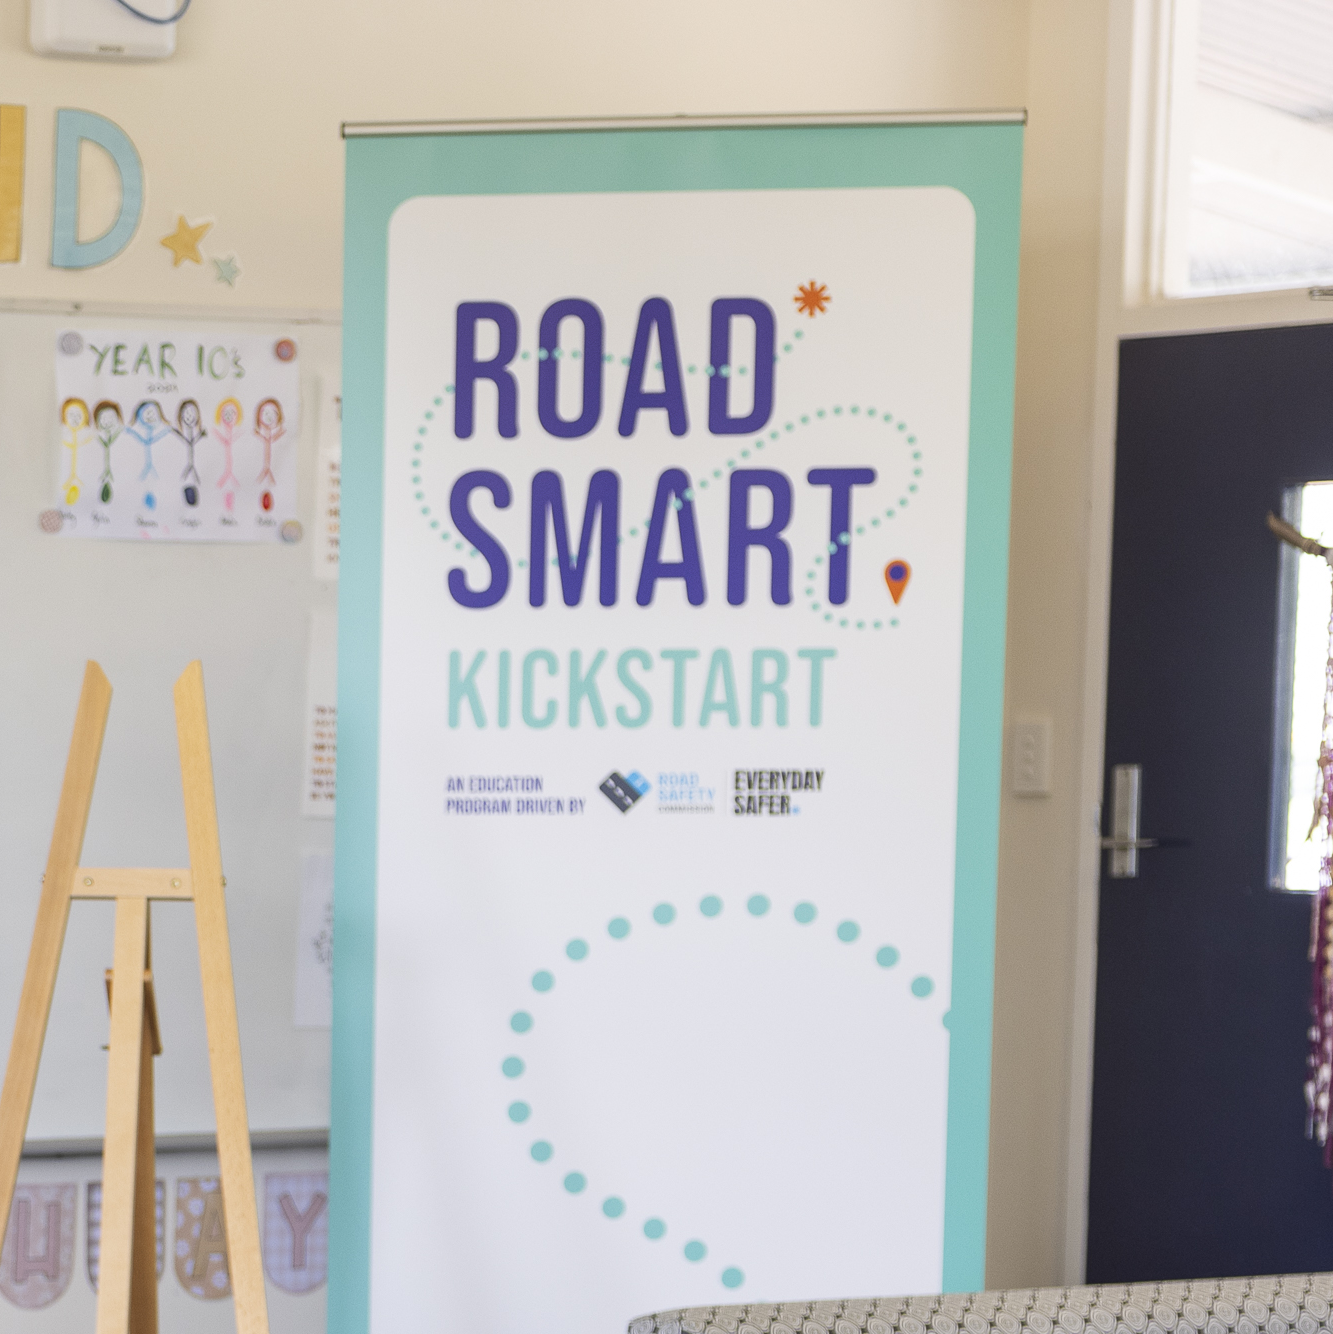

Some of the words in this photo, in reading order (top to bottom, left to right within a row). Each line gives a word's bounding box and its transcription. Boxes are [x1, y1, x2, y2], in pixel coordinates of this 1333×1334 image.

[89, 341, 177, 380] YEAR
[453, 297, 777, 440] ROAD
[447, 468, 878, 610] SMART
[446, 648, 838, 729] KICKSTART
[469, 775, 544, 793] EDUCATION
[733, 769, 826, 793] EVERYDAY
[446, 797, 513, 815] PROGRAM
[516, 797, 565, 815] DRIVEN
[733, 794, 791, 816] SAFER
